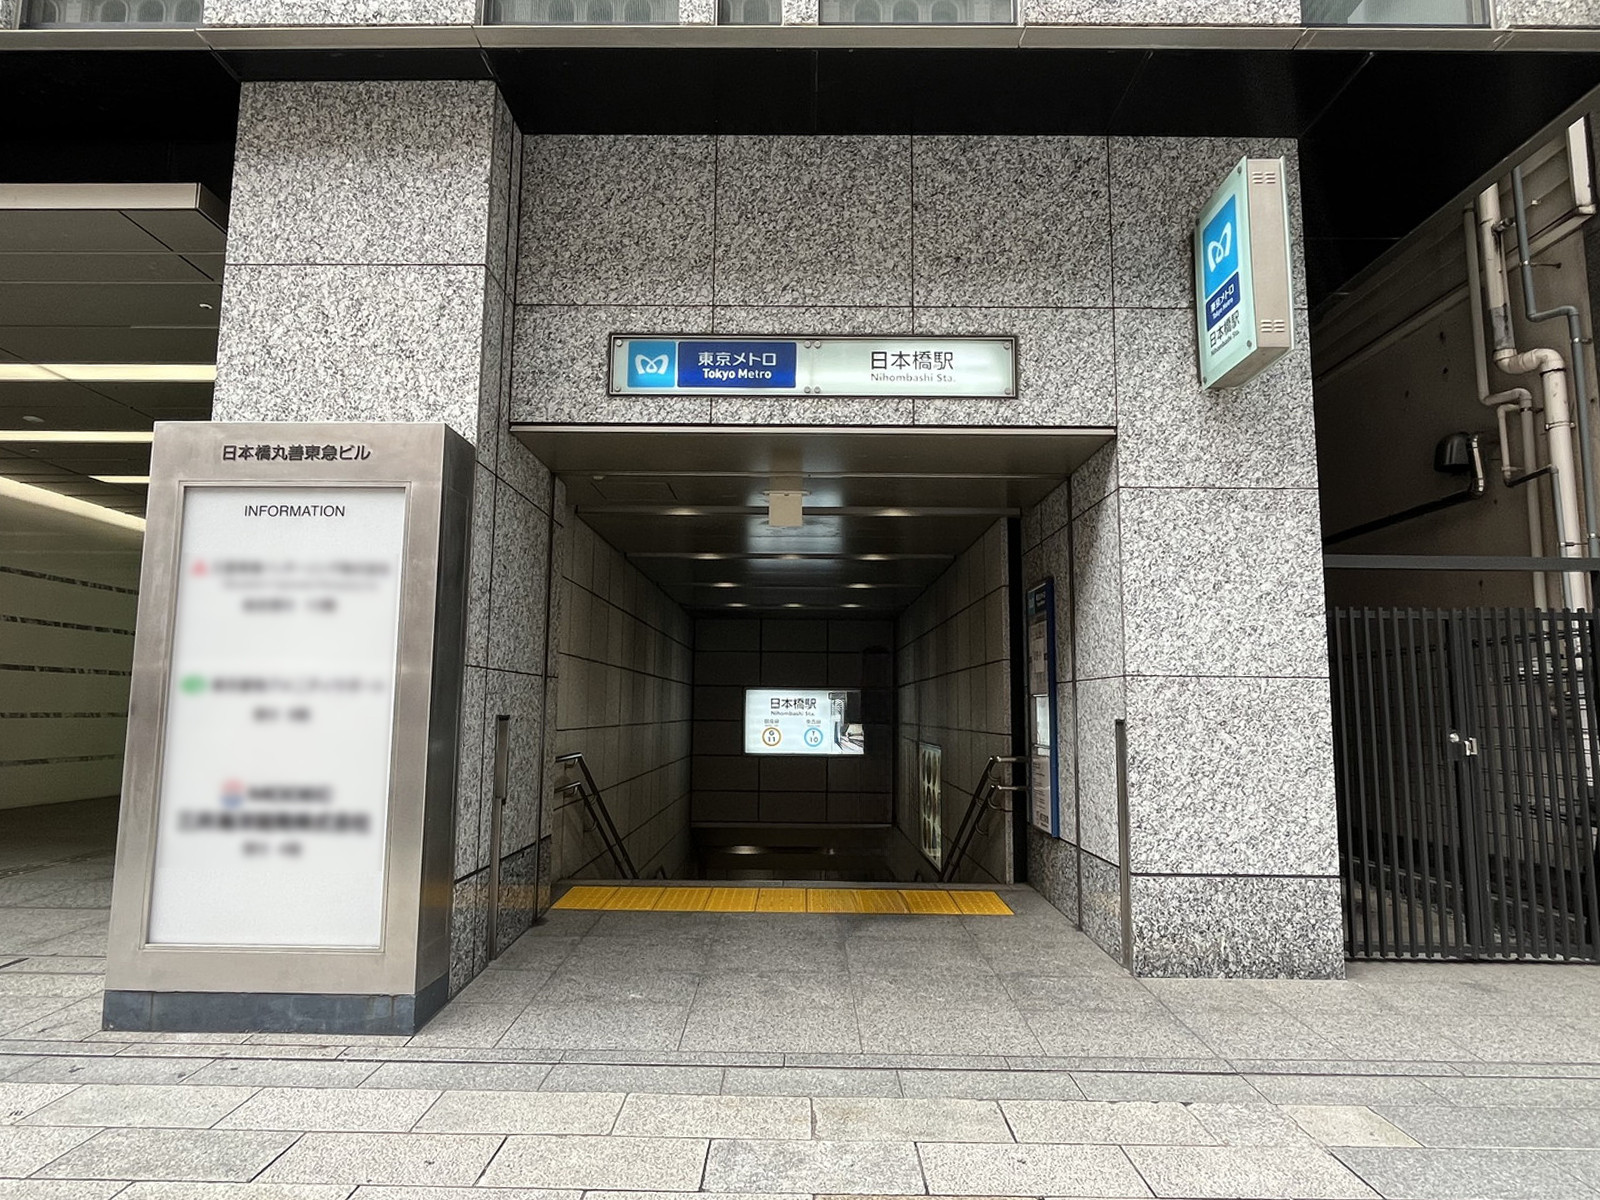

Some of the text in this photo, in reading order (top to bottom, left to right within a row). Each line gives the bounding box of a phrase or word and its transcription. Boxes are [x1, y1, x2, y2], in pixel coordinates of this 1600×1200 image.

[1210, 310, 1239, 348] 日本橋駅
[698, 352, 776, 366] 東京メトロ
[871, 350, 953, 370] 日本橋駅
[702, 368, 772, 381] Tokyo Metro
[870, 373, 956, 382] Nihombashi Sta.
[222, 444, 371, 461] 日本橋丸善東急ビル
[244, 505, 346, 517] INFORMATION
[770, 698, 817, 709] 日本橋駅
